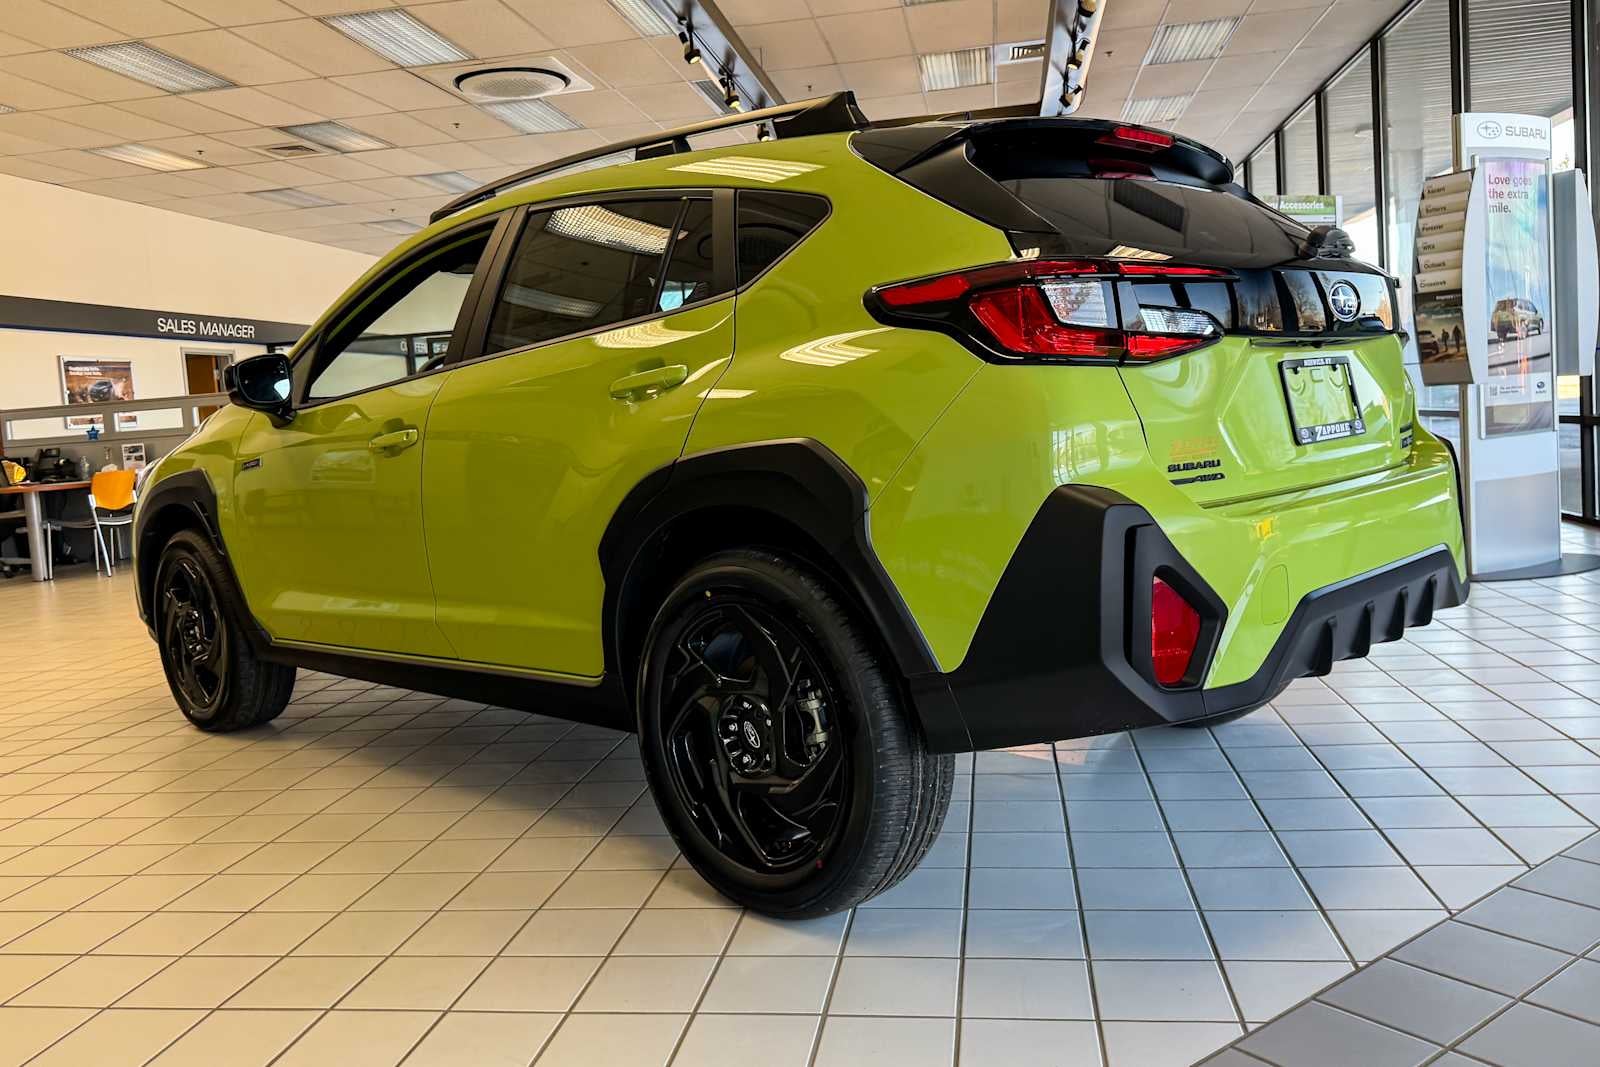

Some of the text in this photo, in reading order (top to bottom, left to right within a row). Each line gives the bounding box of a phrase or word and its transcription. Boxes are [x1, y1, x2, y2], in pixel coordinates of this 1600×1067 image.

[1505, 126, 1546, 140] SUBARU
[1488, 174, 1532, 188] Love goes
[1488, 188, 1529, 200] the extra
[1280, 200, 1325, 209] Accessories
[1488, 202, 1511, 213] mile.
[157, 317, 255, 338] SALES MANAGER
[1167, 458, 1221, 473] SUBARU
